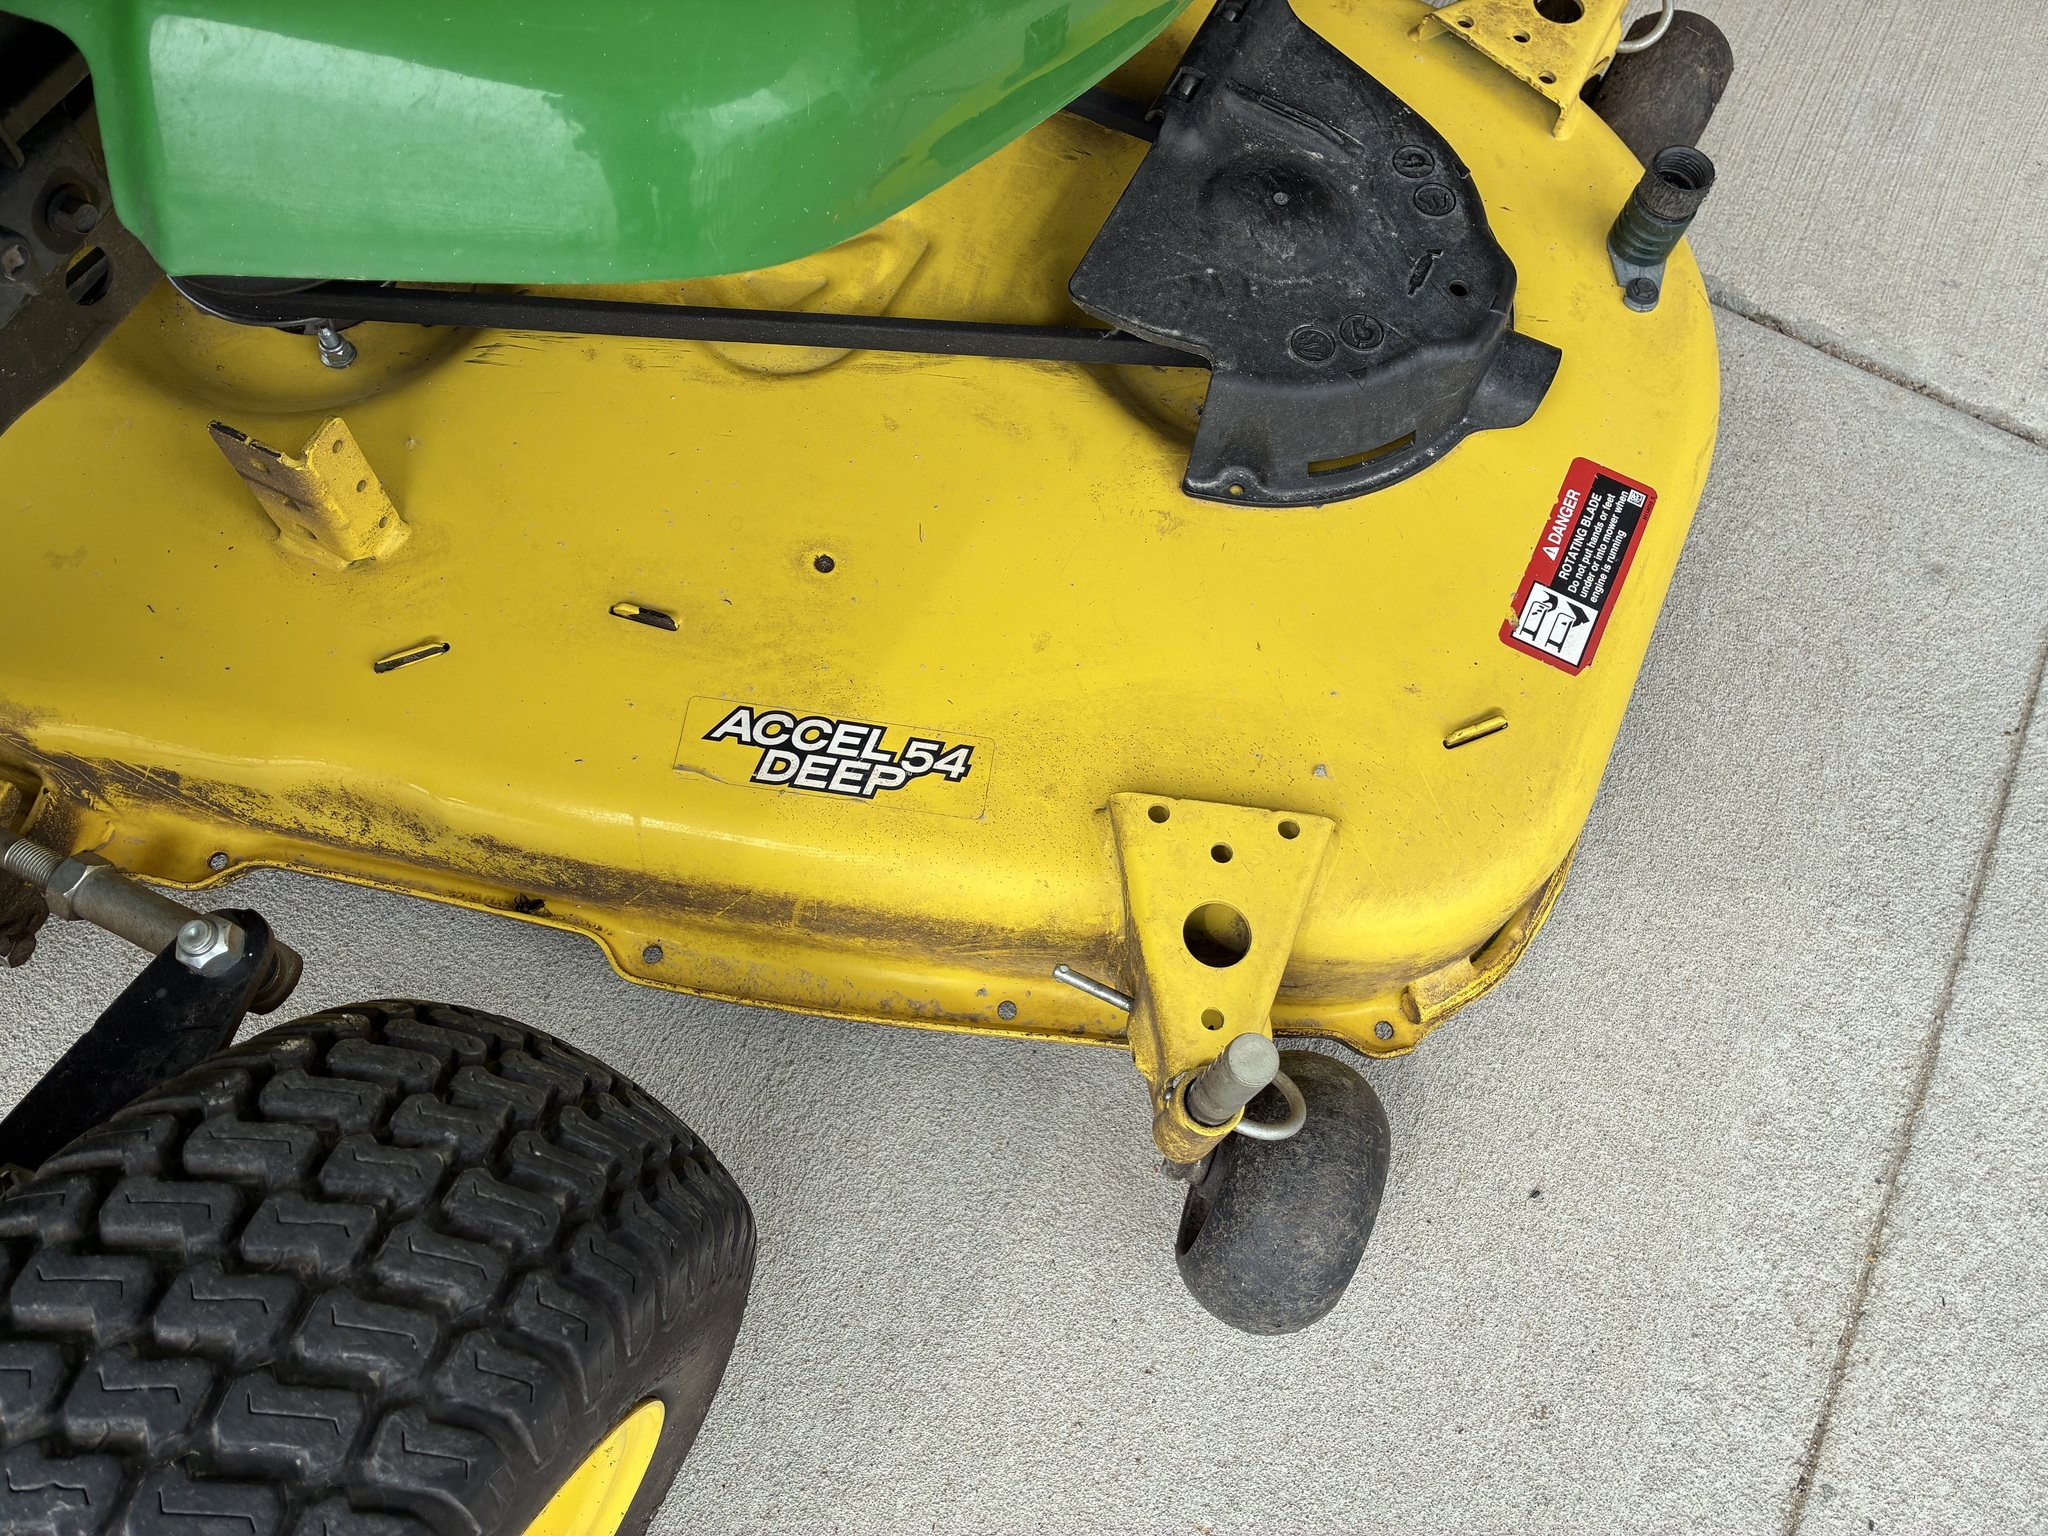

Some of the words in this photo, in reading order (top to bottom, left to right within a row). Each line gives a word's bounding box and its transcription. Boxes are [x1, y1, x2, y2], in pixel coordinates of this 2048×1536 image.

[1602, 493, 1616, 510] feet
[1614, 490, 1629, 513] when
[1547, 489, 1581, 545] DANGER
[1600, 510, 1608, 521] or
[1558, 528, 1588, 580] ROTATING
[1580, 492, 1602, 527] BLADE
[1586, 521, 1604, 548] hands
[1602, 513, 1619, 543] mower
[1582, 548, 1593, 565] put
[1593, 543, 1607, 561] into
[1575, 563, 1587, 579] not
[1590, 573, 1608, 603] engine
[1601, 563, 1611, 573] is
[1606, 529, 1627, 564] running
[1591, 561, 1600, 572] or
[1567, 580, 1580, 593] Do
[1580, 572, 1595, 598] under
[706, 707, 896, 763] ACCEL
[900, 739, 973, 780] 54
[753, 748, 907, 797] DEEP
